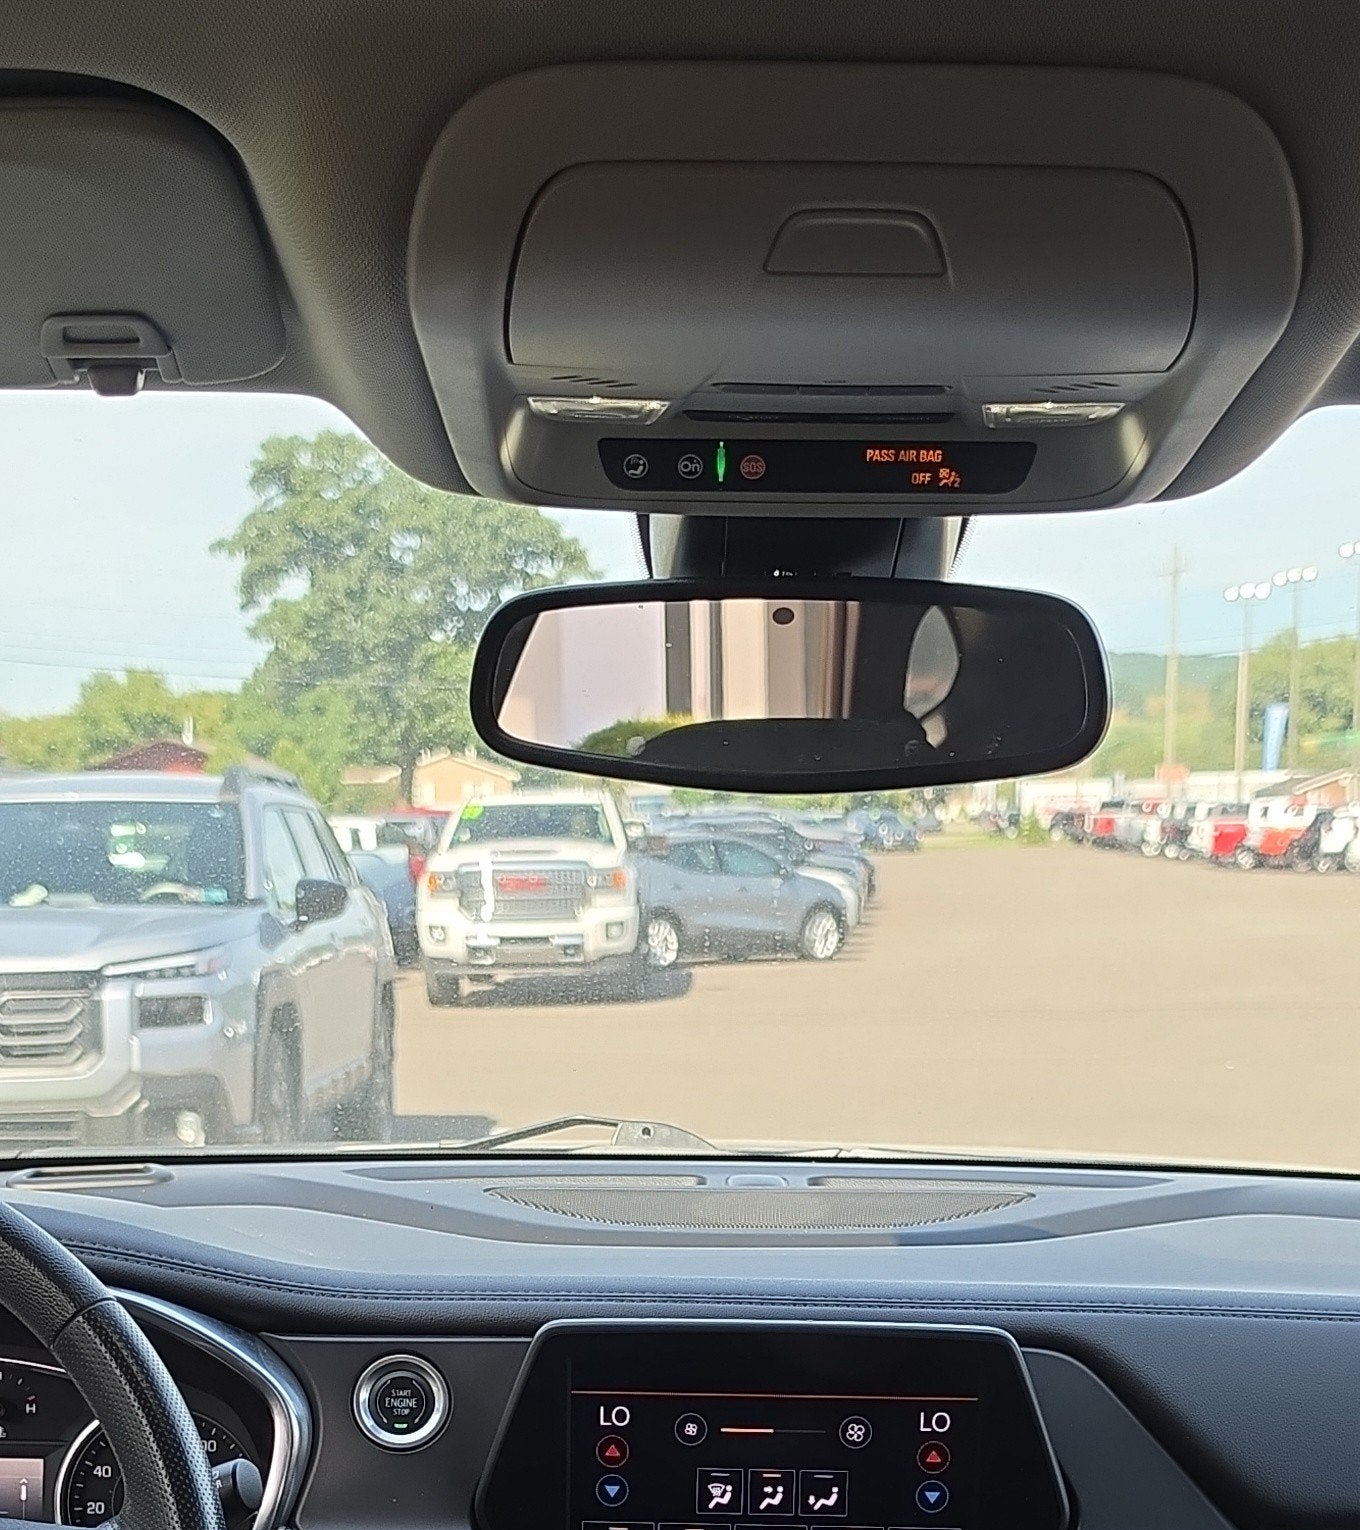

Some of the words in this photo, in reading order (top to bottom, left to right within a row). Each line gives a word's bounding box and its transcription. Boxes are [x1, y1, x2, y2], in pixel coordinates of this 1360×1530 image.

[866, 449, 896, 462] PASS
[898, 450, 917, 462] AIR
[920, 450, 943, 462] BAG
[742, 462, 763, 473] SOS
[911, 472, 932, 484] OFF
[391, 1389, 412, 1397] START
[26, 1404, 36, 1414] H
[385, 1398, 417, 1408] ENGINE
[393, 1408, 410, 1416] STOP
[598, 1405, 631, 1427] LO
[919, 1412, 951, 1433] LO
[93, 1465, 111, 1478] 40
[86, 1502, 104, 1514] 20
